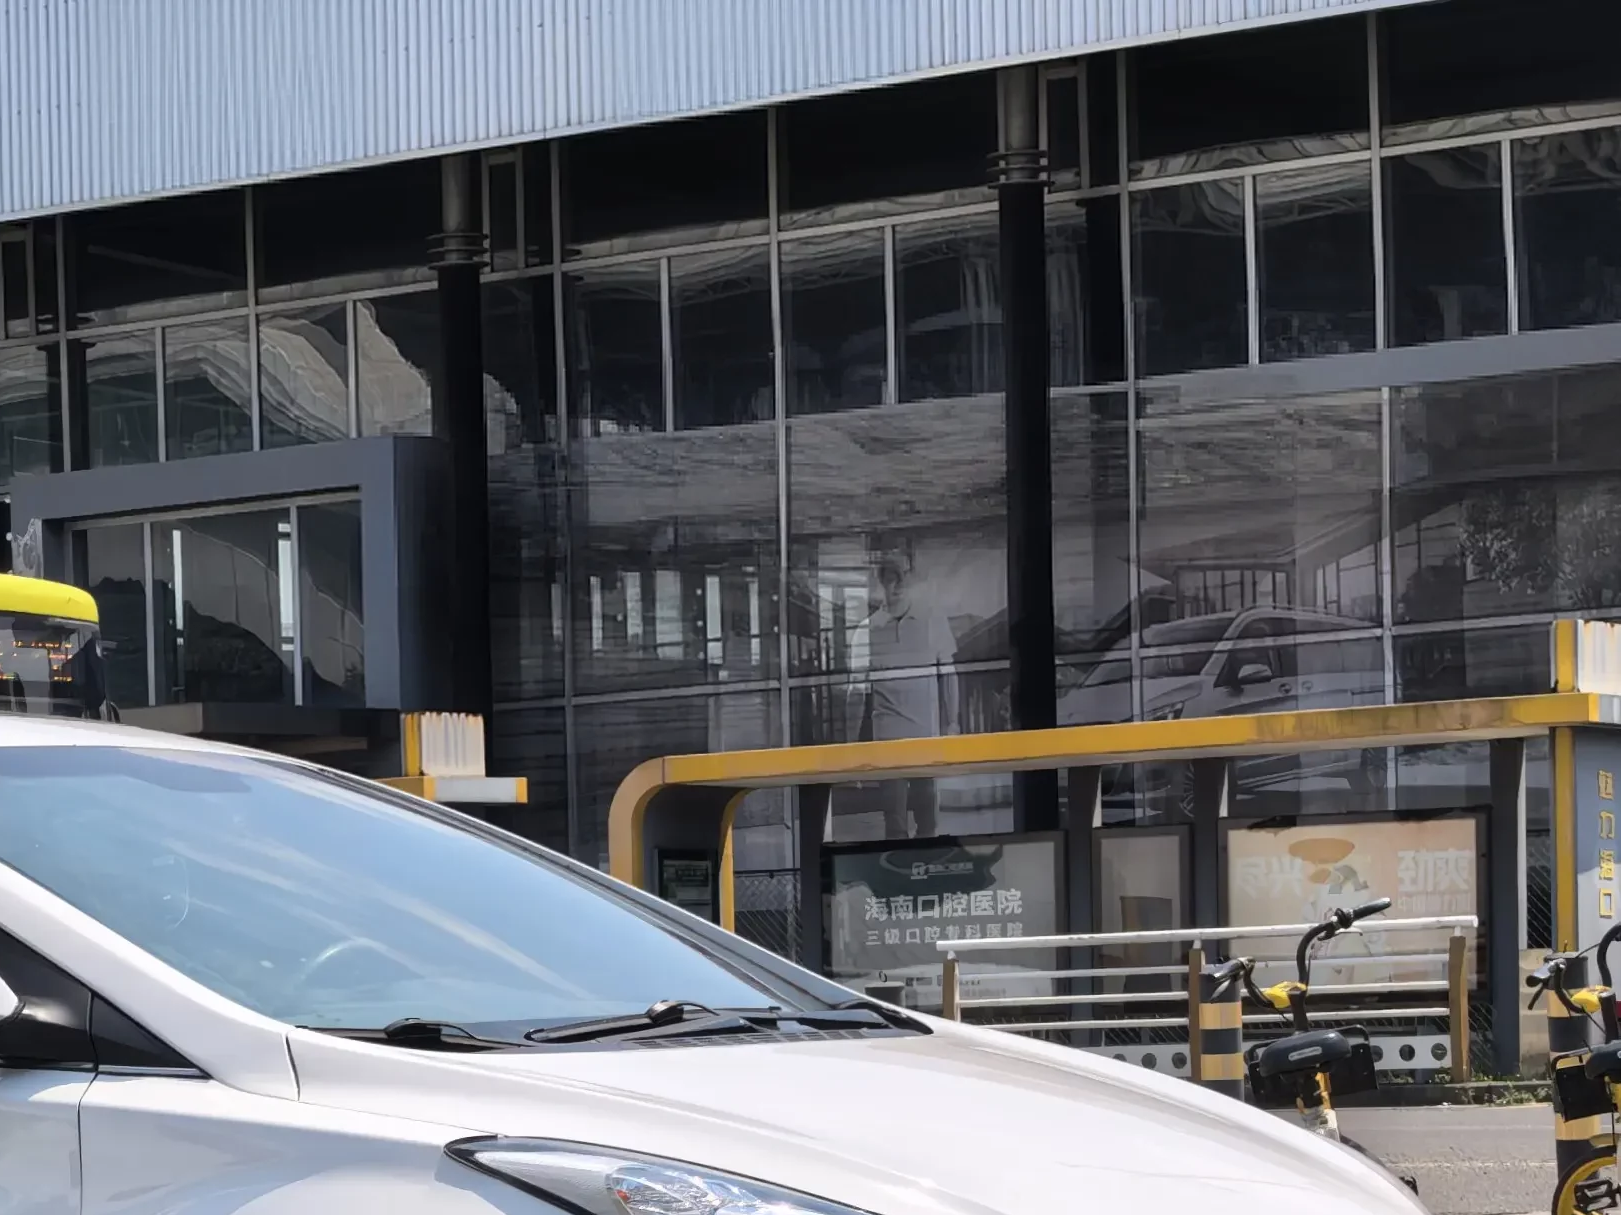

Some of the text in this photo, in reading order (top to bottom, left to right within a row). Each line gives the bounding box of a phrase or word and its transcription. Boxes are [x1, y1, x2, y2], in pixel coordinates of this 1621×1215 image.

[864, 888, 1023, 921] 海南口腔医院
[865, 922, 1024, 945] 三级口腔专科医院
